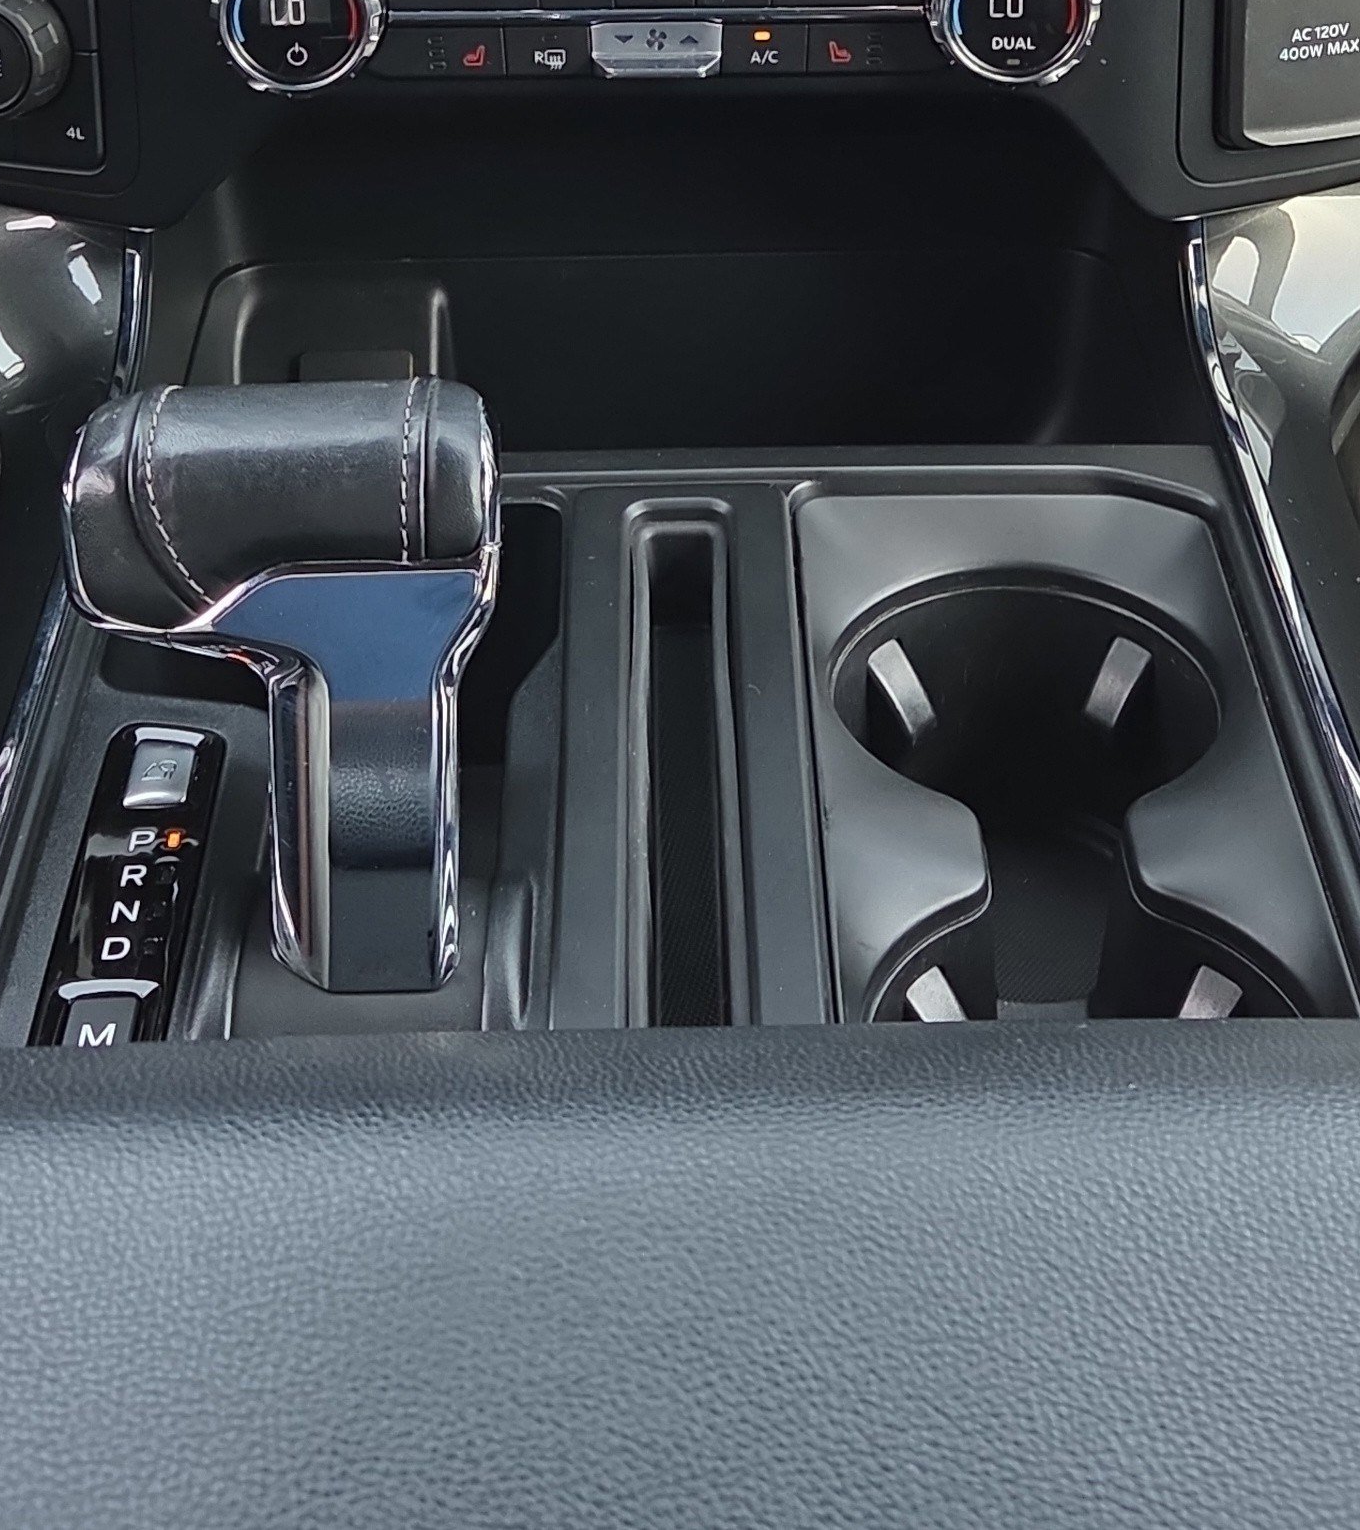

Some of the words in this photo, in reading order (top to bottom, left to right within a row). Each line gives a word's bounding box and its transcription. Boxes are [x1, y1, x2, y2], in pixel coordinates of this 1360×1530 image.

[1291, 28, 1313, 43] AC
[1314, 23, 1350, 39] 120V
[991, 37, 1036, 51] DUAL
[1279, 44, 1322, 62] 400W
[1327, 38, 1360, 54] MAX
[750, 50, 779, 66] A/C
[66, 127, 85, 141] 4L
[129, 831, 155, 852] P
[120, 865, 147, 887] R
[111, 901, 140, 923] N
[101, 937, 131, 960] D
[78, 1023, 117, 1047] M
